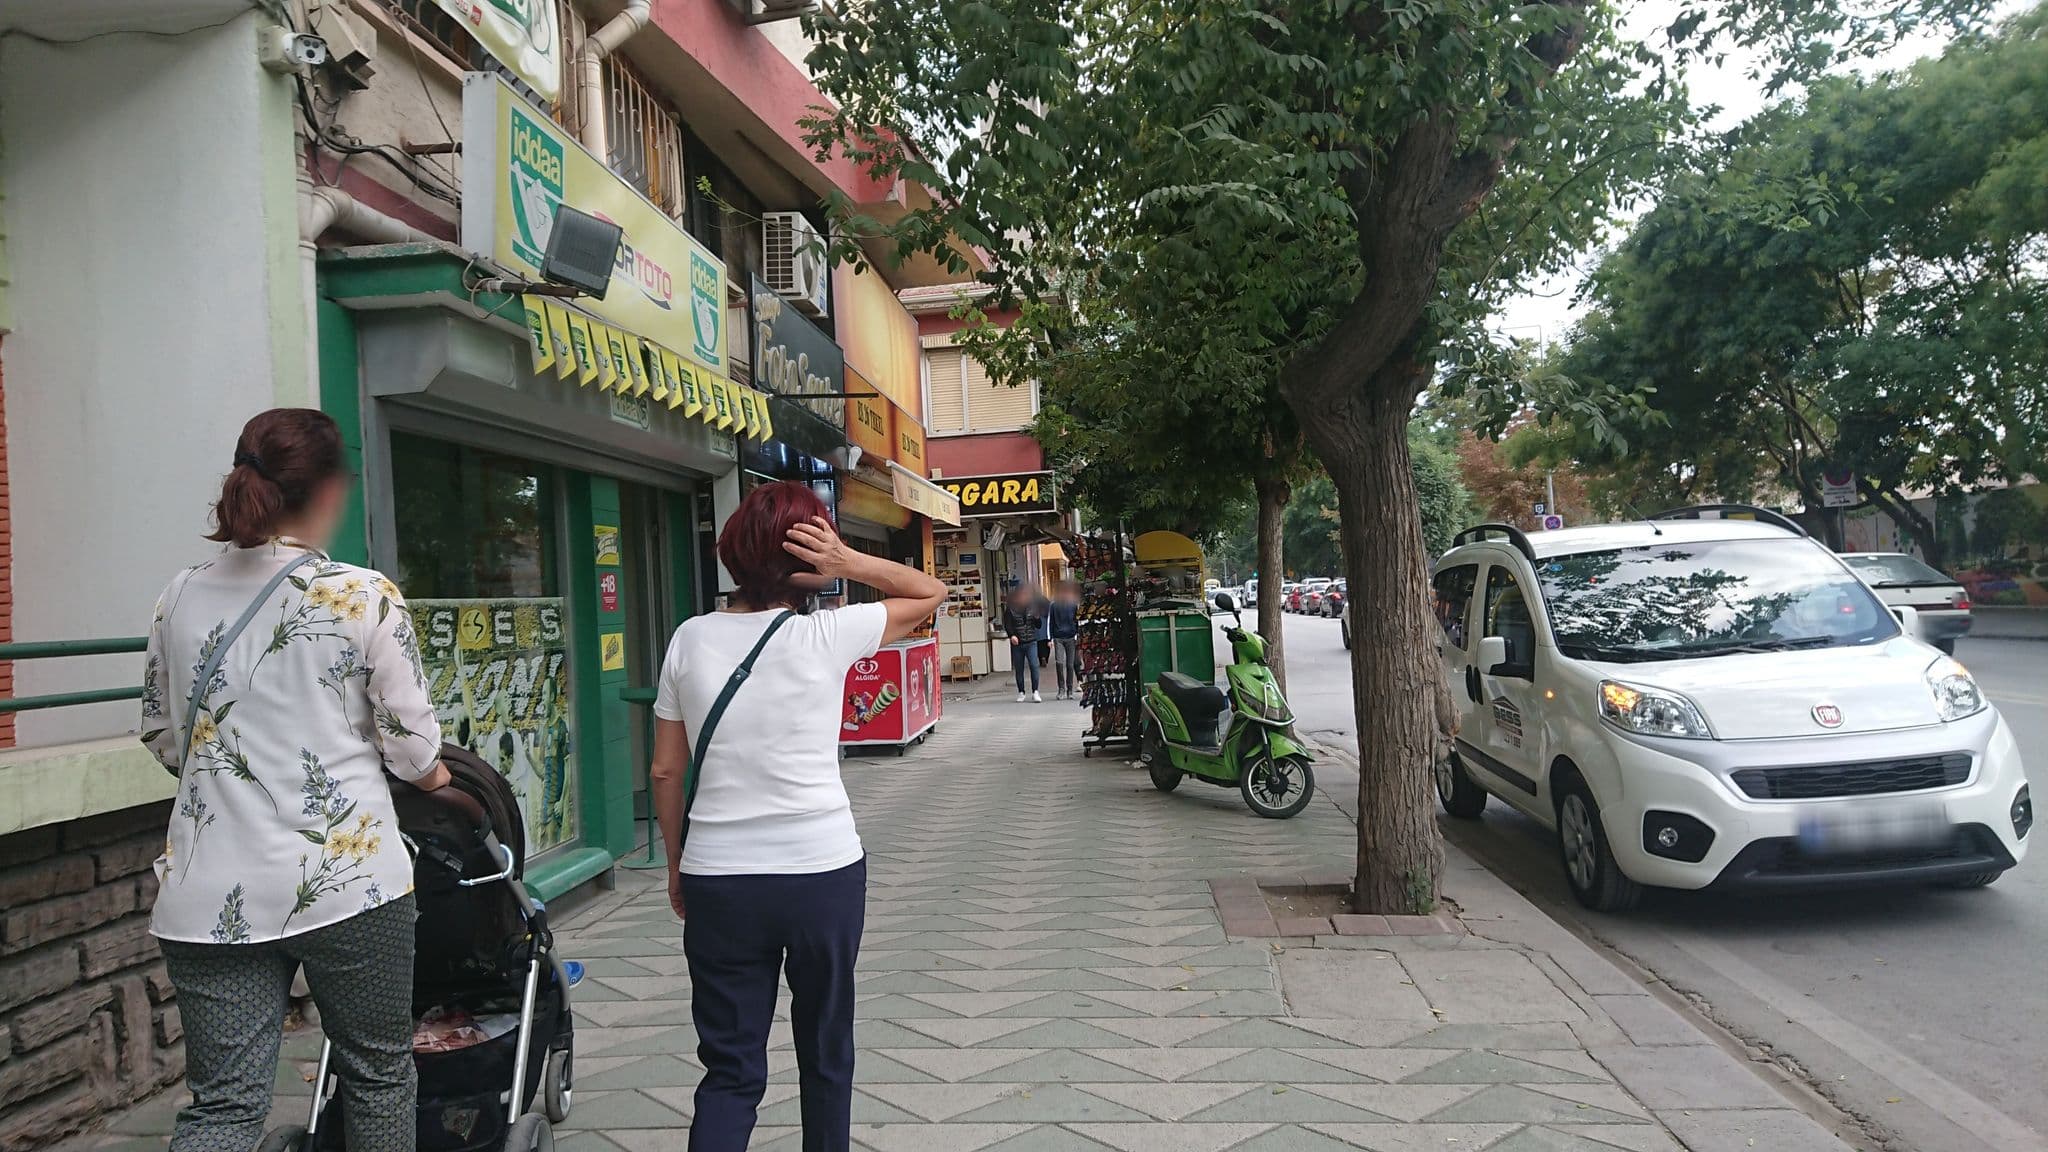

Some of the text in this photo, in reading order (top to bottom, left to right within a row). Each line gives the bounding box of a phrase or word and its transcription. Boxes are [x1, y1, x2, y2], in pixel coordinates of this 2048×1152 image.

[514, 116, 561, 187] iddaa
[614, 239, 672, 300] ORTOTO
[692, 256, 717, 300] iddaa
